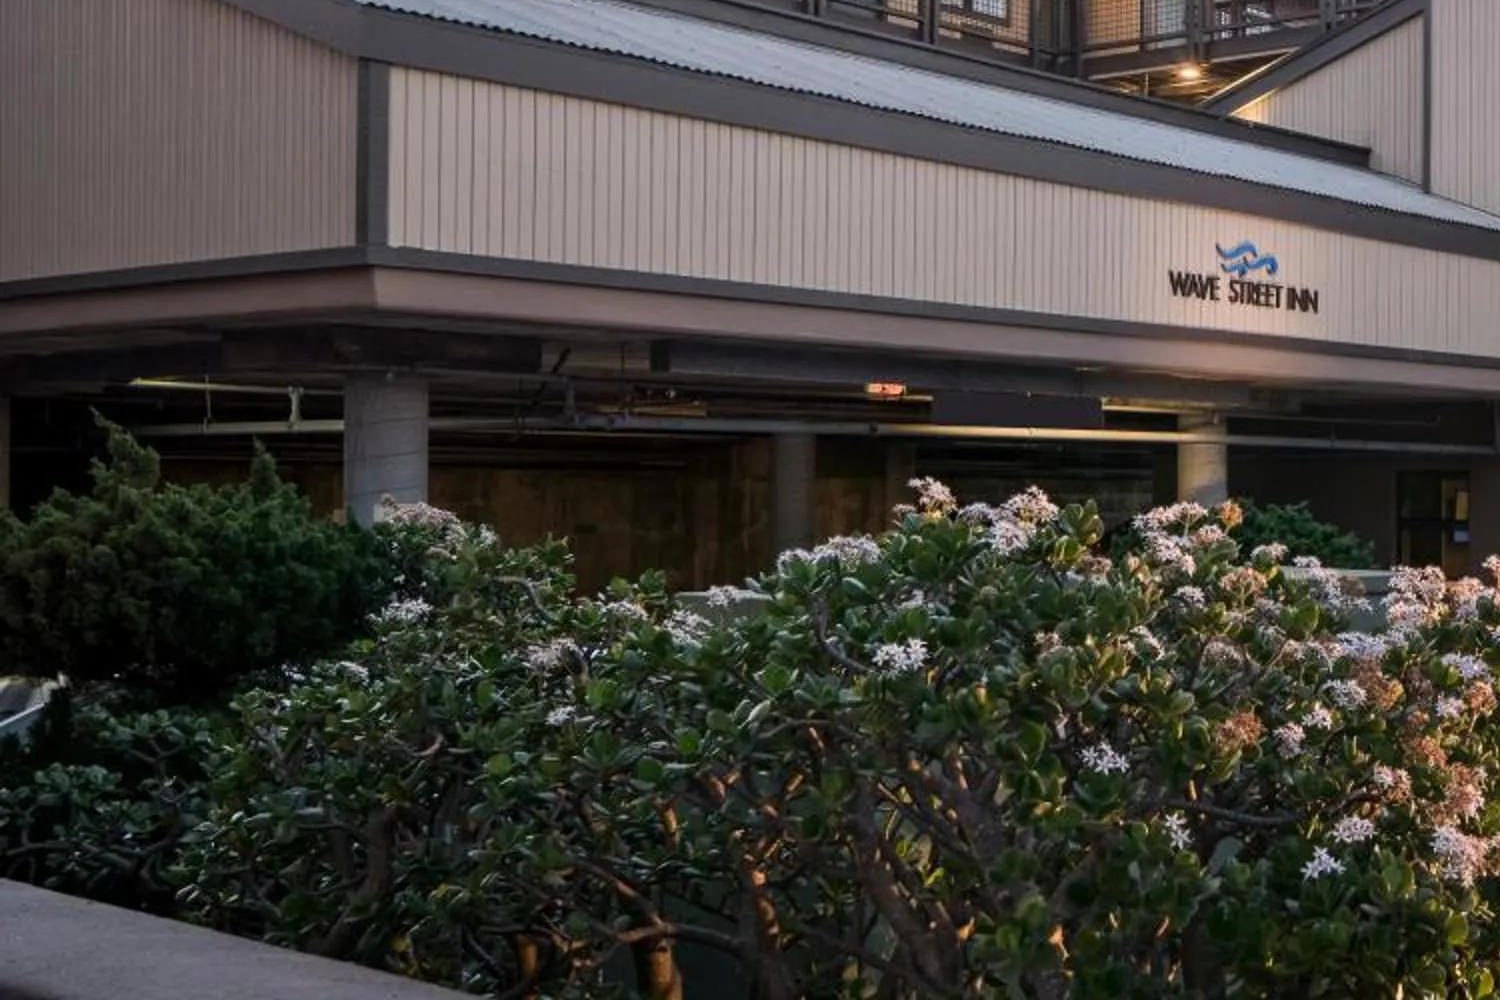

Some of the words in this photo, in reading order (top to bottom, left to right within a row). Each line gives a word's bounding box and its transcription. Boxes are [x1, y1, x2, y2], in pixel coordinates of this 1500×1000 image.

[1169, 269, 1220, 301] WAVE
[1228, 279, 1283, 308] STREET
[1287, 286, 1318, 314] INN
